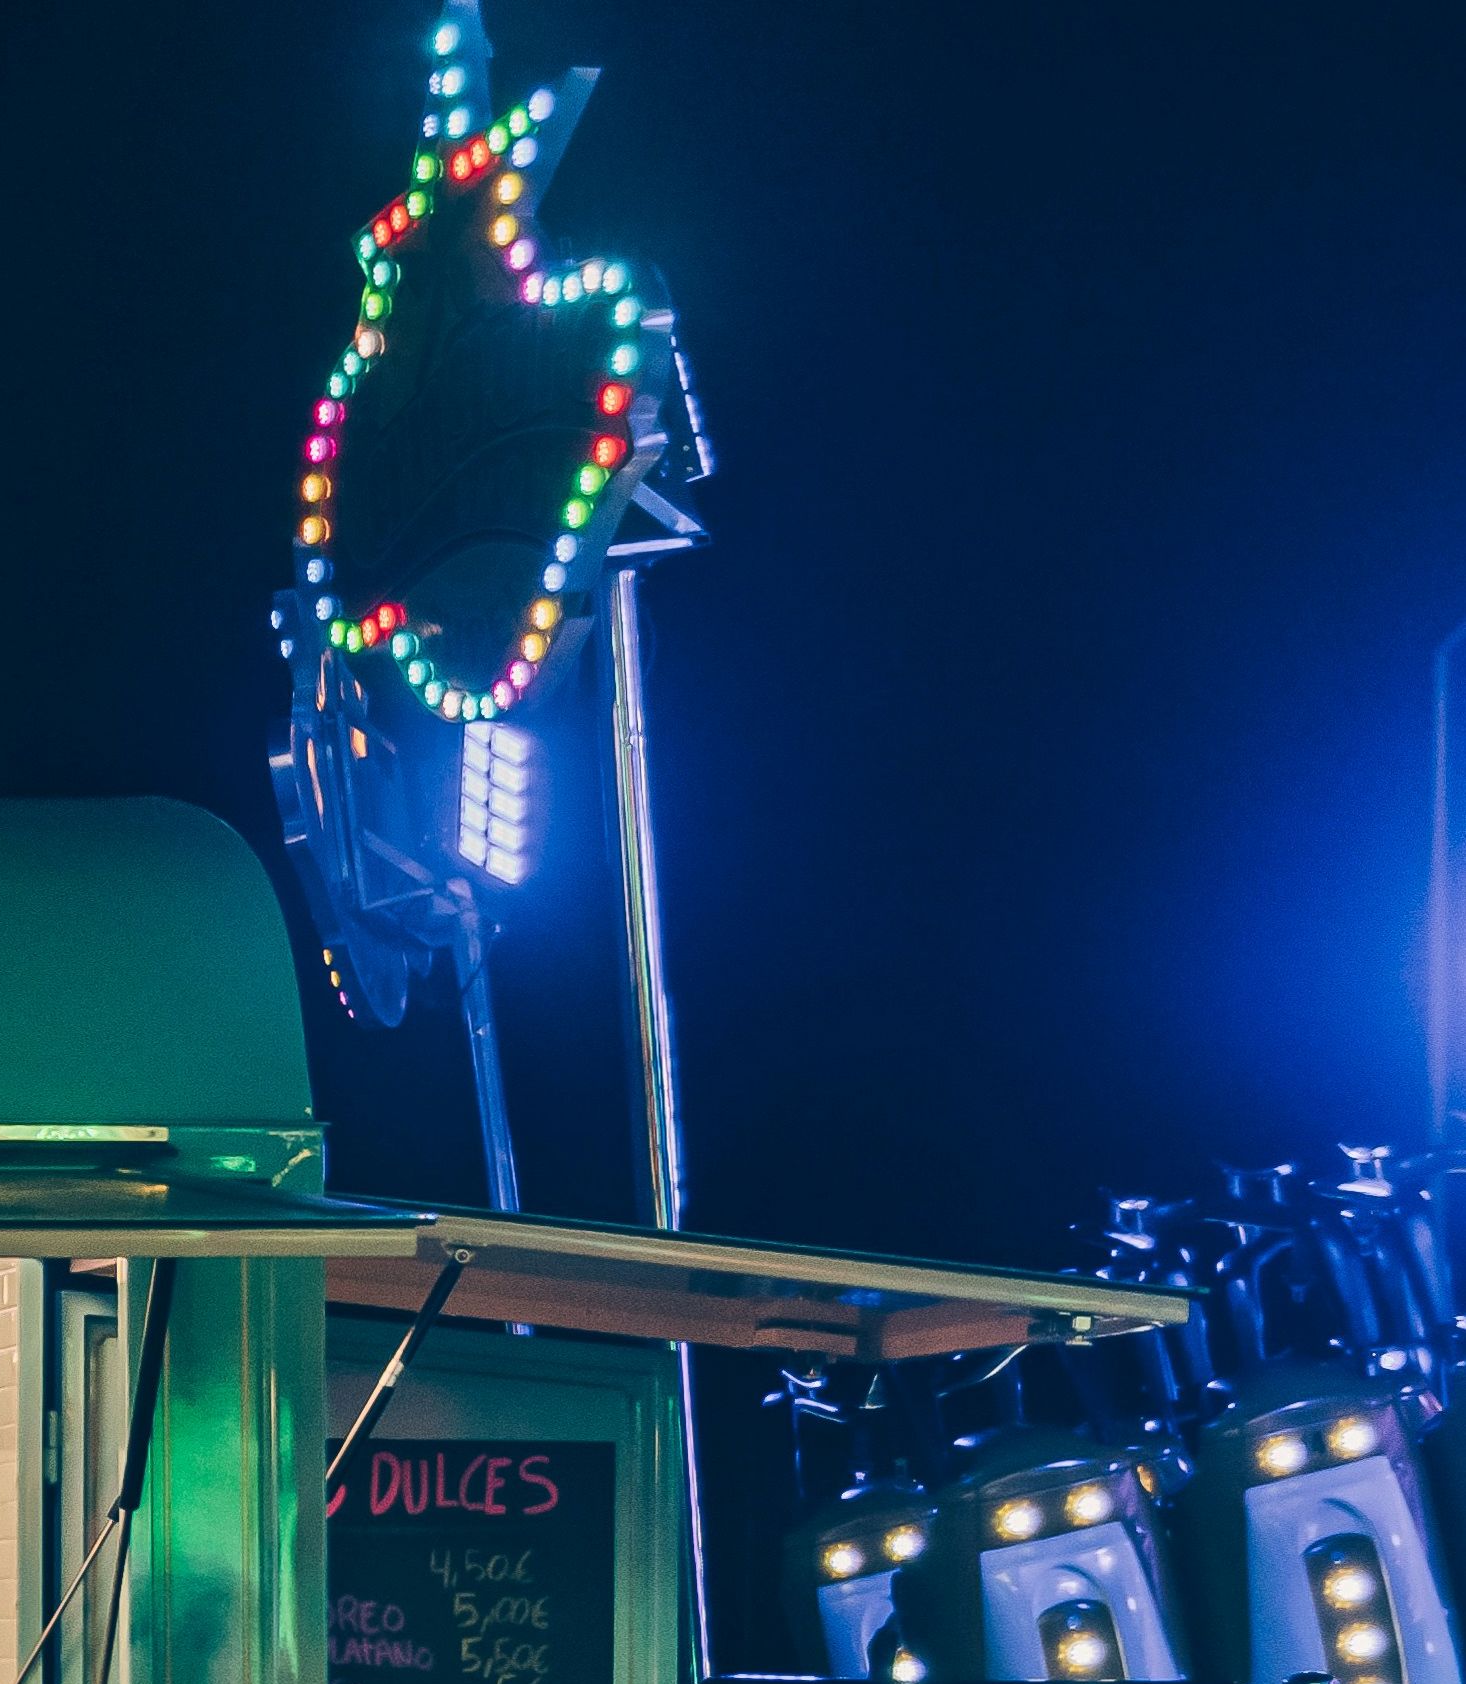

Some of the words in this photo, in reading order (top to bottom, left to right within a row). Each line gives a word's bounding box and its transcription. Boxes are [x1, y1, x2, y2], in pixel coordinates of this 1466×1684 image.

[369, 1452, 560, 1517] DULCES
[428, 1548, 533, 1590] 4,50€
[460, 1635, 551, 1679] 5,50€
